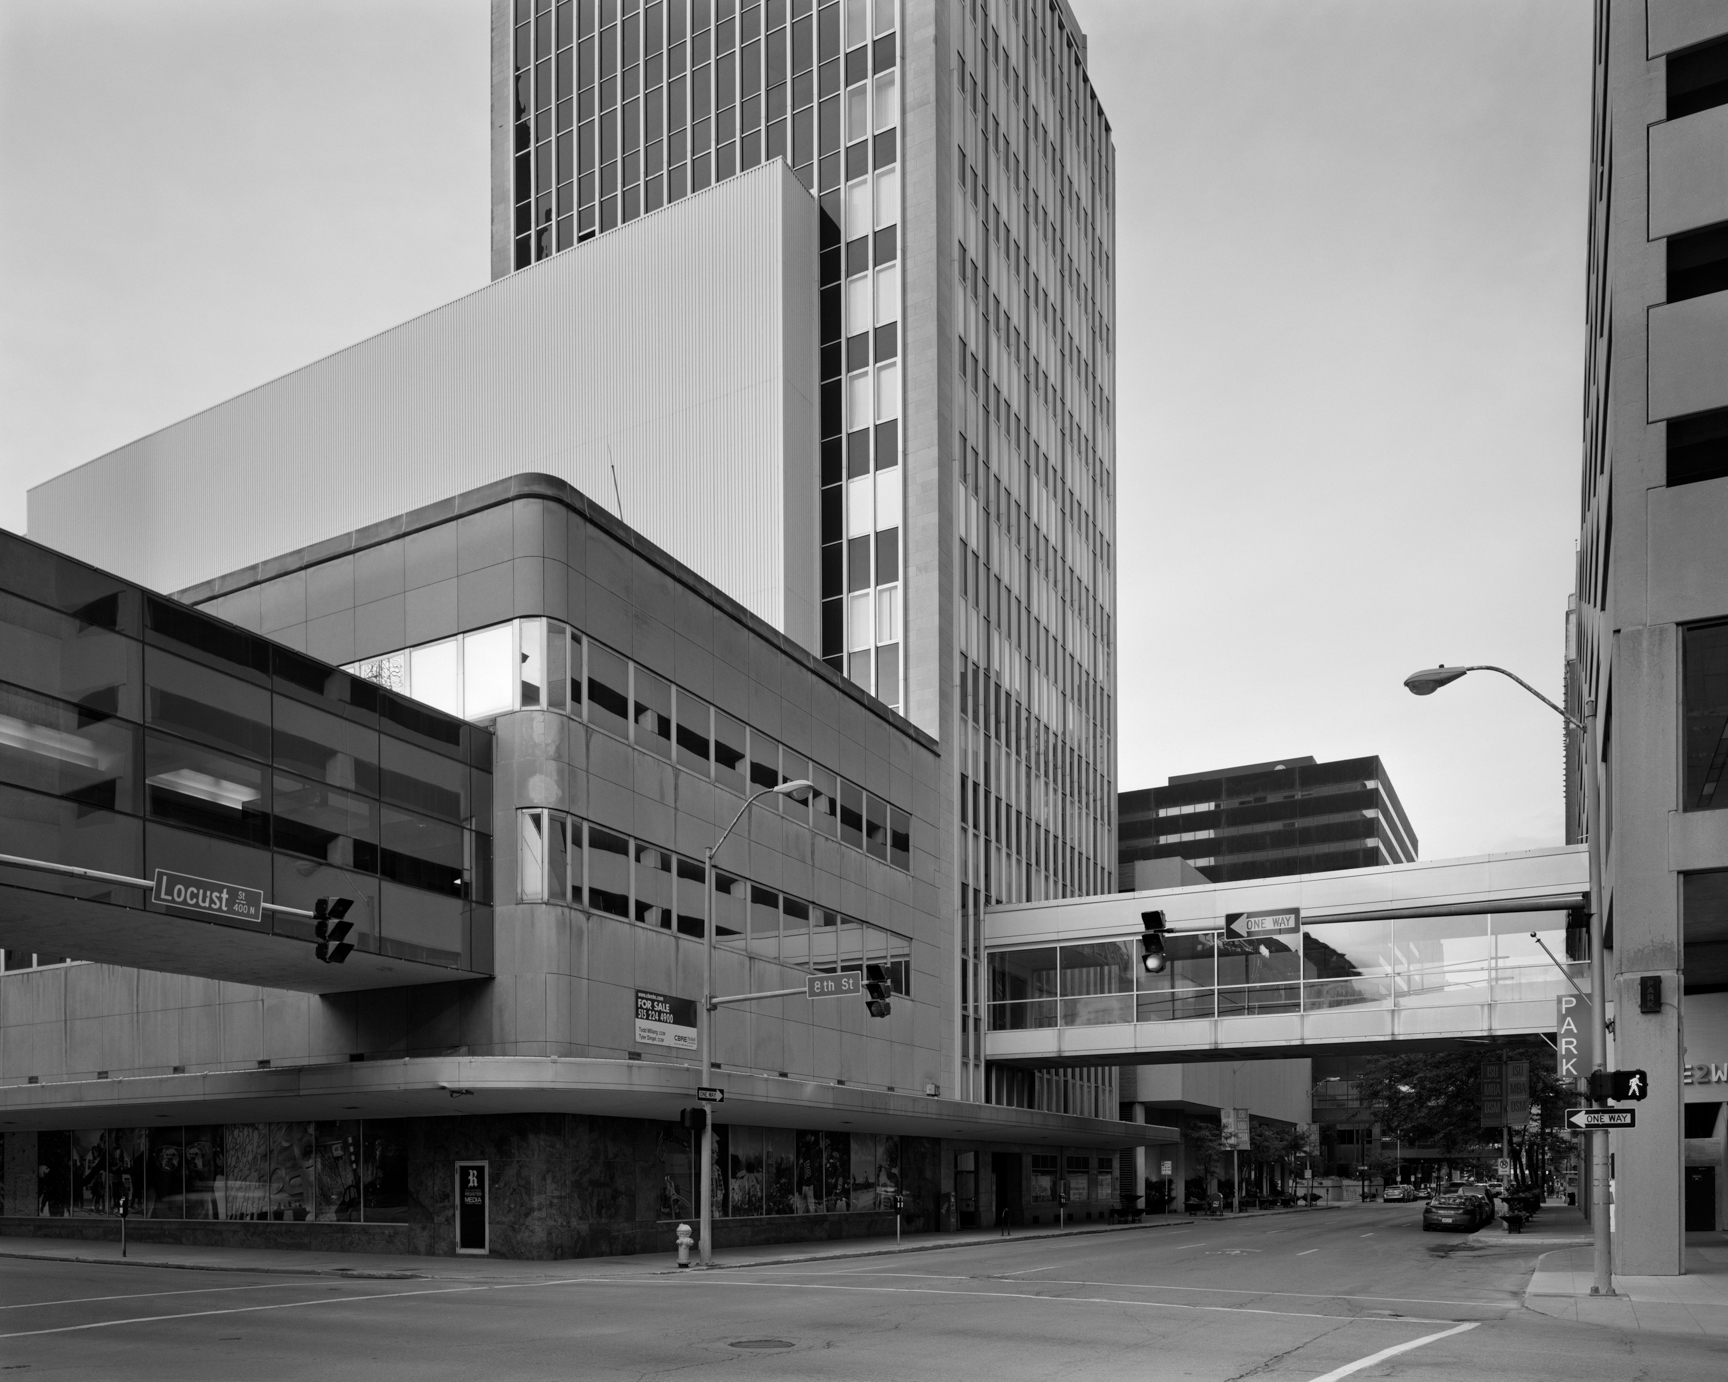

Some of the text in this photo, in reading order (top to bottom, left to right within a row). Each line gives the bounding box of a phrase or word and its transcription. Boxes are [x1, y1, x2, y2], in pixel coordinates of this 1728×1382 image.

[160, 875, 228, 911] Locust
[237, 890, 246, 900] St
[233, 904, 255, 915] 400 N
[1246, 916, 1291, 930] ONE WAY
[814, 978, 854, 992] 8th St
[1646, 979, 1655, 1009] PARK
[638, 998, 670, 1013] FOR SALE
[638, 1008, 674, 1023] 515 224 4900
[674, 1034, 688, 1043] CBRE
[1560, 997, 1579, 1076] PARK
[1487, 1065, 1499, 1078] ISU
[1512, 1064, 1524, 1077] ISU
[1484, 1083, 1501, 1096] MBA
[1510, 1083, 1527, 1095] MBA
[1484, 1101, 1501, 1114] DSM
[1511, 1100, 1527, 1113] DSM
[1586, 1114, 1628, 1123] ONE WAY
[468, 1169, 478, 1188] R
